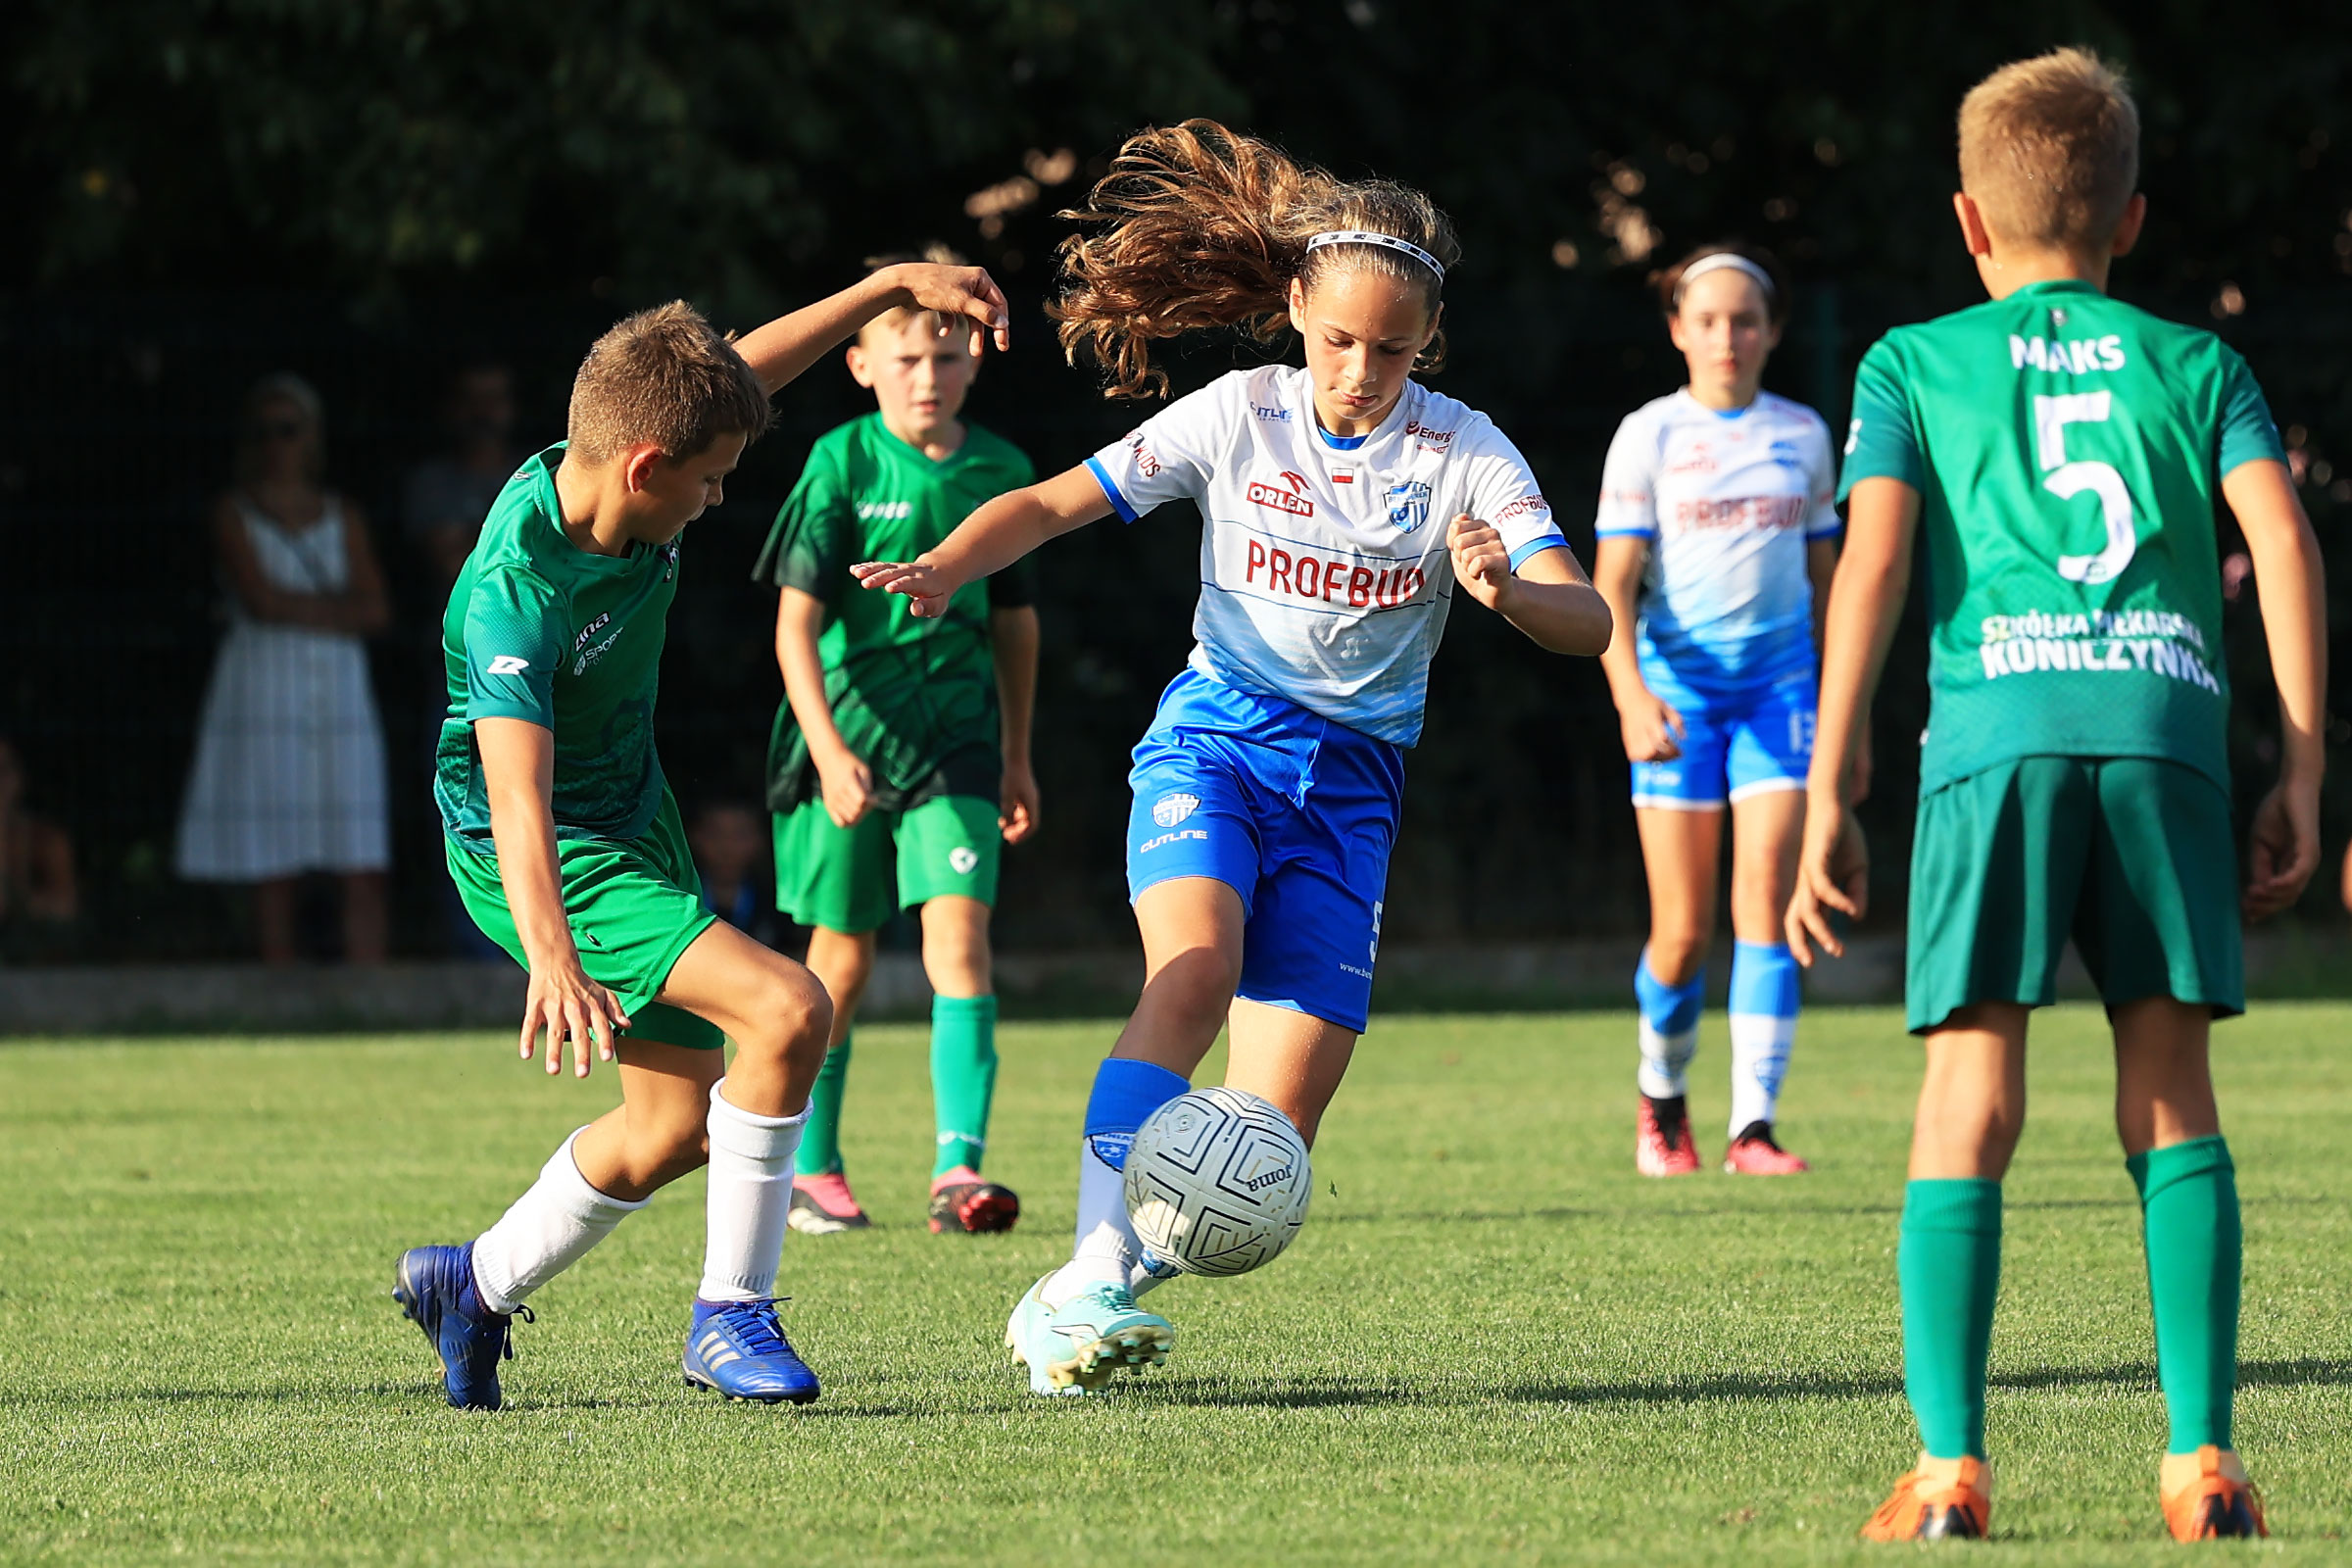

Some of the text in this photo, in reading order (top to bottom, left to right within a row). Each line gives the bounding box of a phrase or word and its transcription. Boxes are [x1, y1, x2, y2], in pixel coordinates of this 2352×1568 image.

[2009, 334, 2126, 374] MAKS
[1134, 445, 1160, 477] KIDS
[1250, 485, 1310, 514] ORLEN
[2034, 390, 2136, 584] 5
[1981, 609, 2089, 644] SZKÓŁKA
[1140, 830, 1208, 854] OUTLINE
